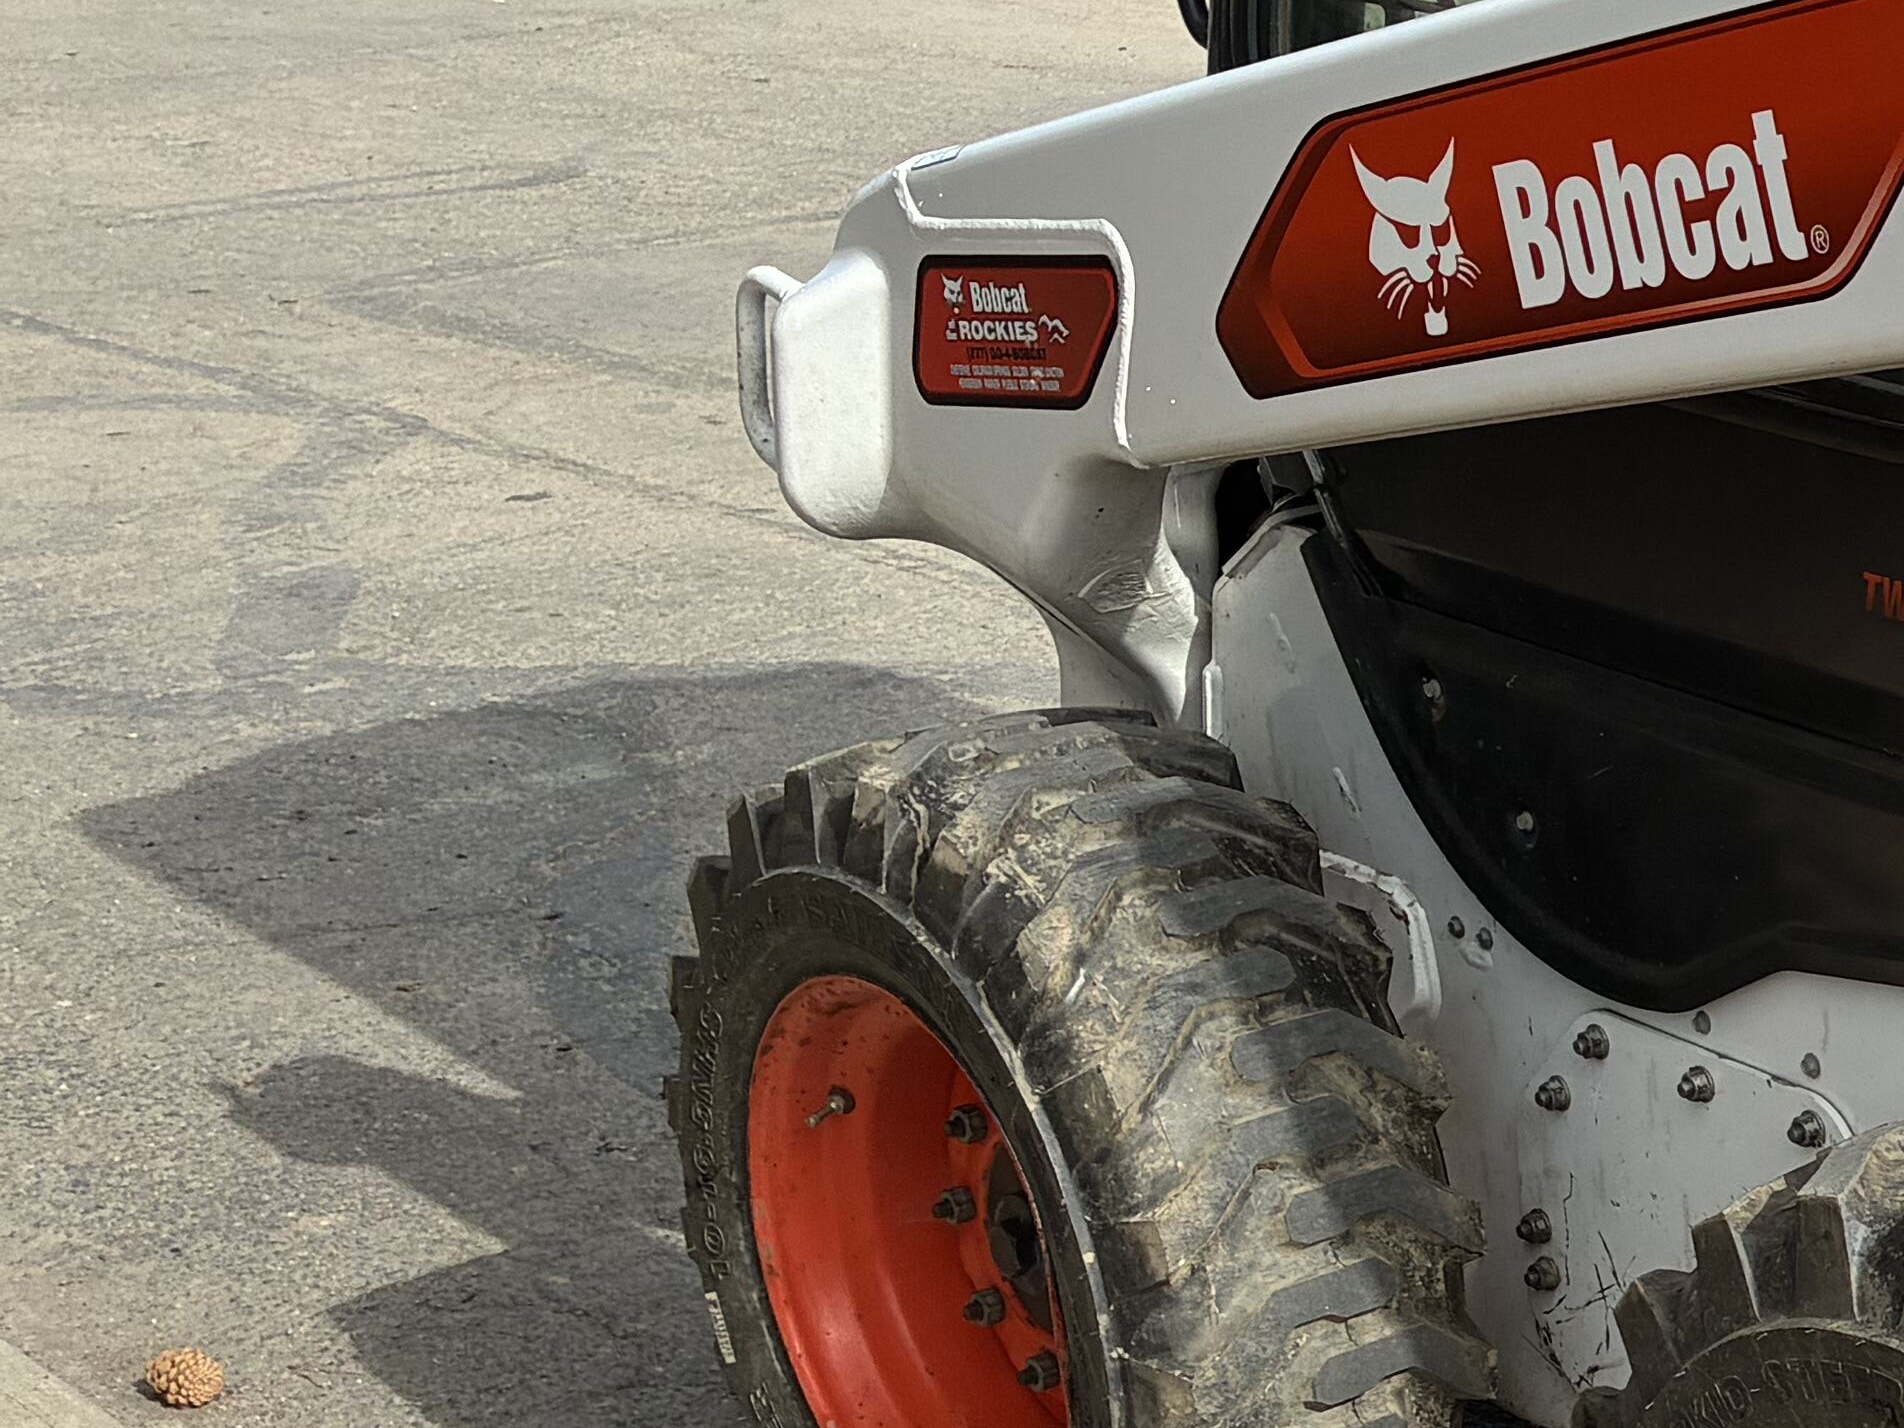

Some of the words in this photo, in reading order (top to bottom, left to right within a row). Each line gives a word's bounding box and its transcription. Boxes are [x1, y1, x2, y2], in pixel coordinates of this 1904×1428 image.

[1491, 108, 1810, 310] Bobcat
[969, 281, 1030, 314] Bobcat
[958, 319, 1039, 342] ROCKIES
